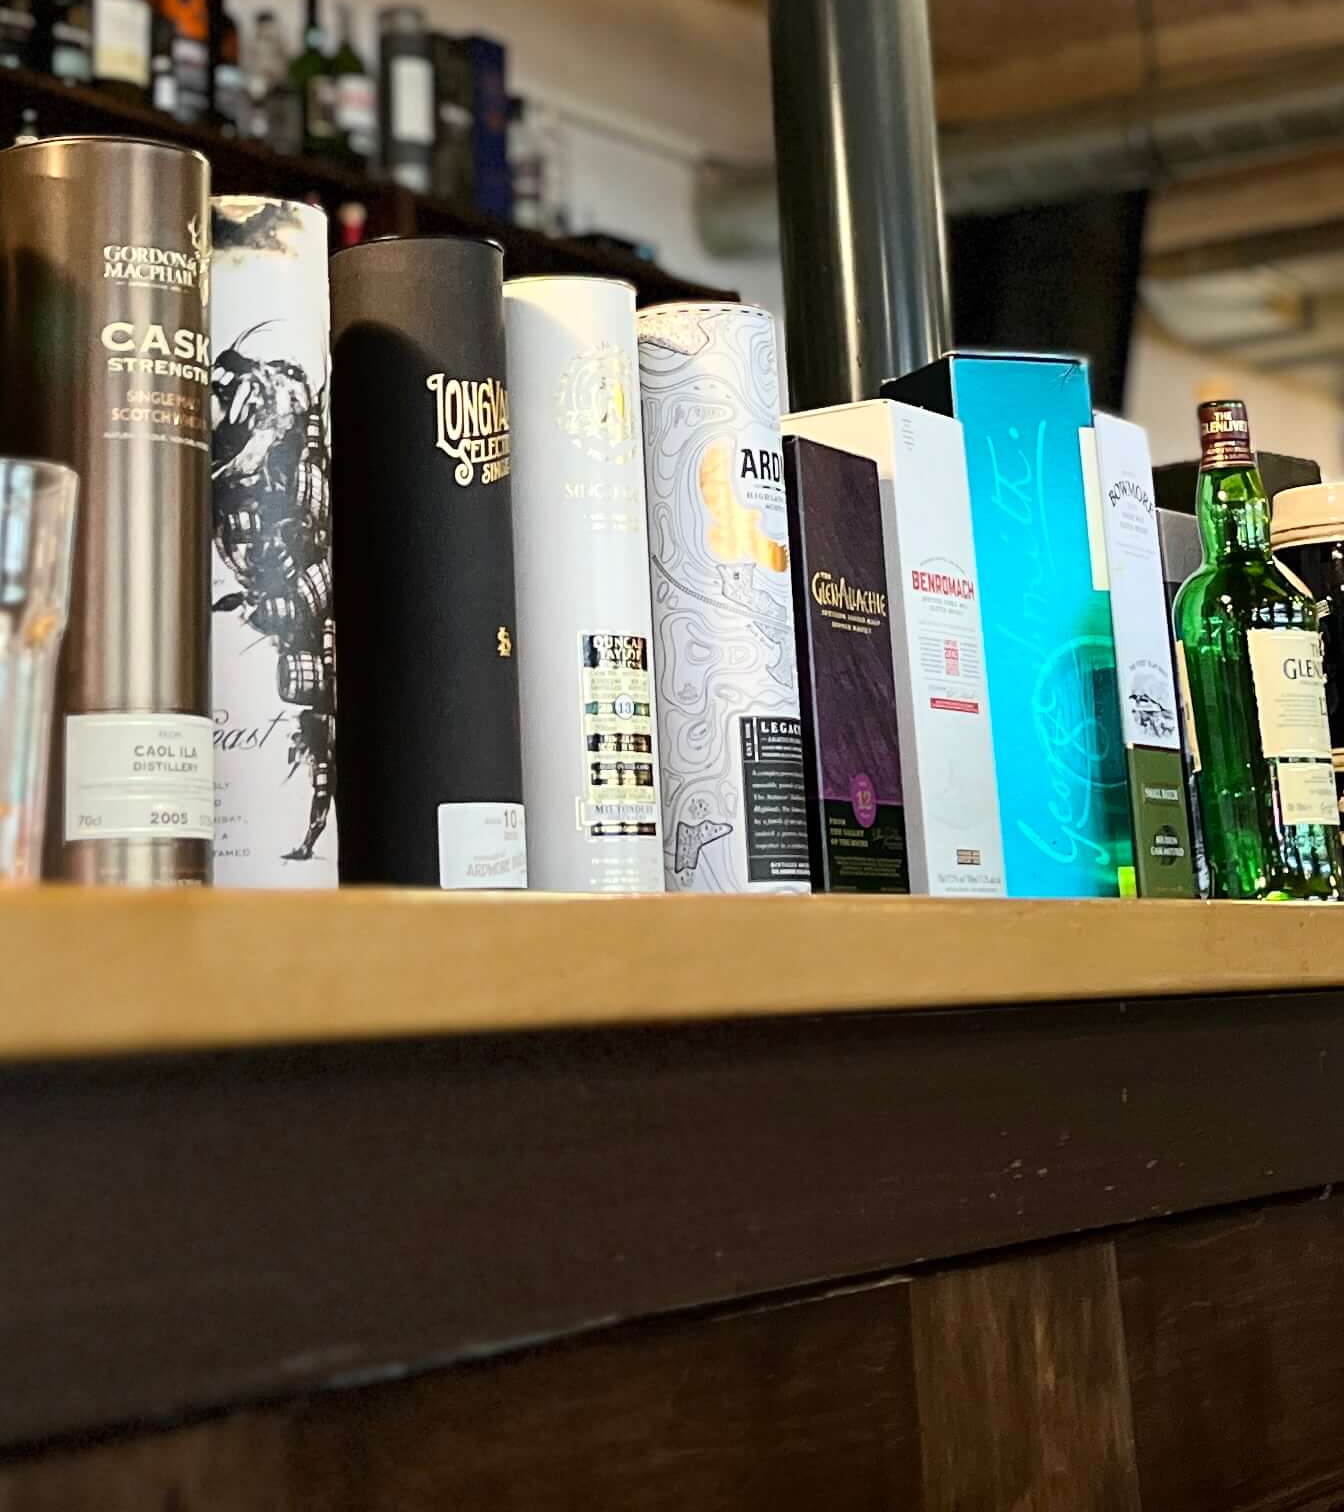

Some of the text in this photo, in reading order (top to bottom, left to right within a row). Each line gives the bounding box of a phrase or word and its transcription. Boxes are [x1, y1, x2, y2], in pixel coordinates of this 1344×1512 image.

[103, 245, 187, 268] GORDON
[100, 321, 210, 367] CASK
[111, 407, 172, 425] SCOTCH
[741, 448, 783, 483] ARD
[1108, 479, 1155, 520] BOWMORE
[911, 569, 976, 601] BENROMACH
[134, 745, 198, 759] CAOL ILA
[149, 811, 189, 825] 2005
[504, 809, 517, 829] 10
